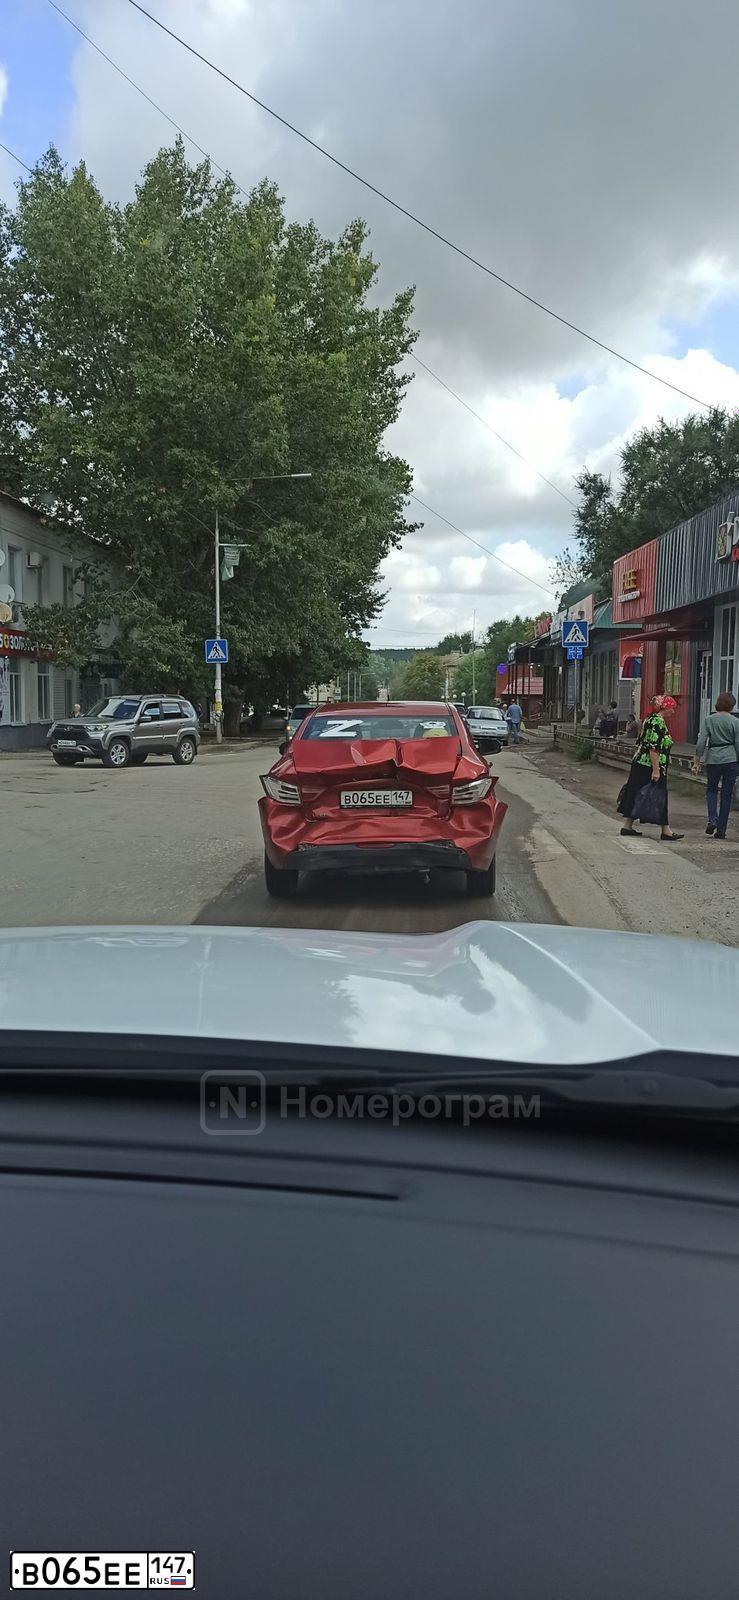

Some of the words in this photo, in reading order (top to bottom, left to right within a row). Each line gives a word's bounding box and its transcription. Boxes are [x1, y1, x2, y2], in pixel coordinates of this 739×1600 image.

[319, 719, 363, 737] Z
[344, 792, 391, 804] В065ЕЕ
[393, 791, 410, 801] 147
